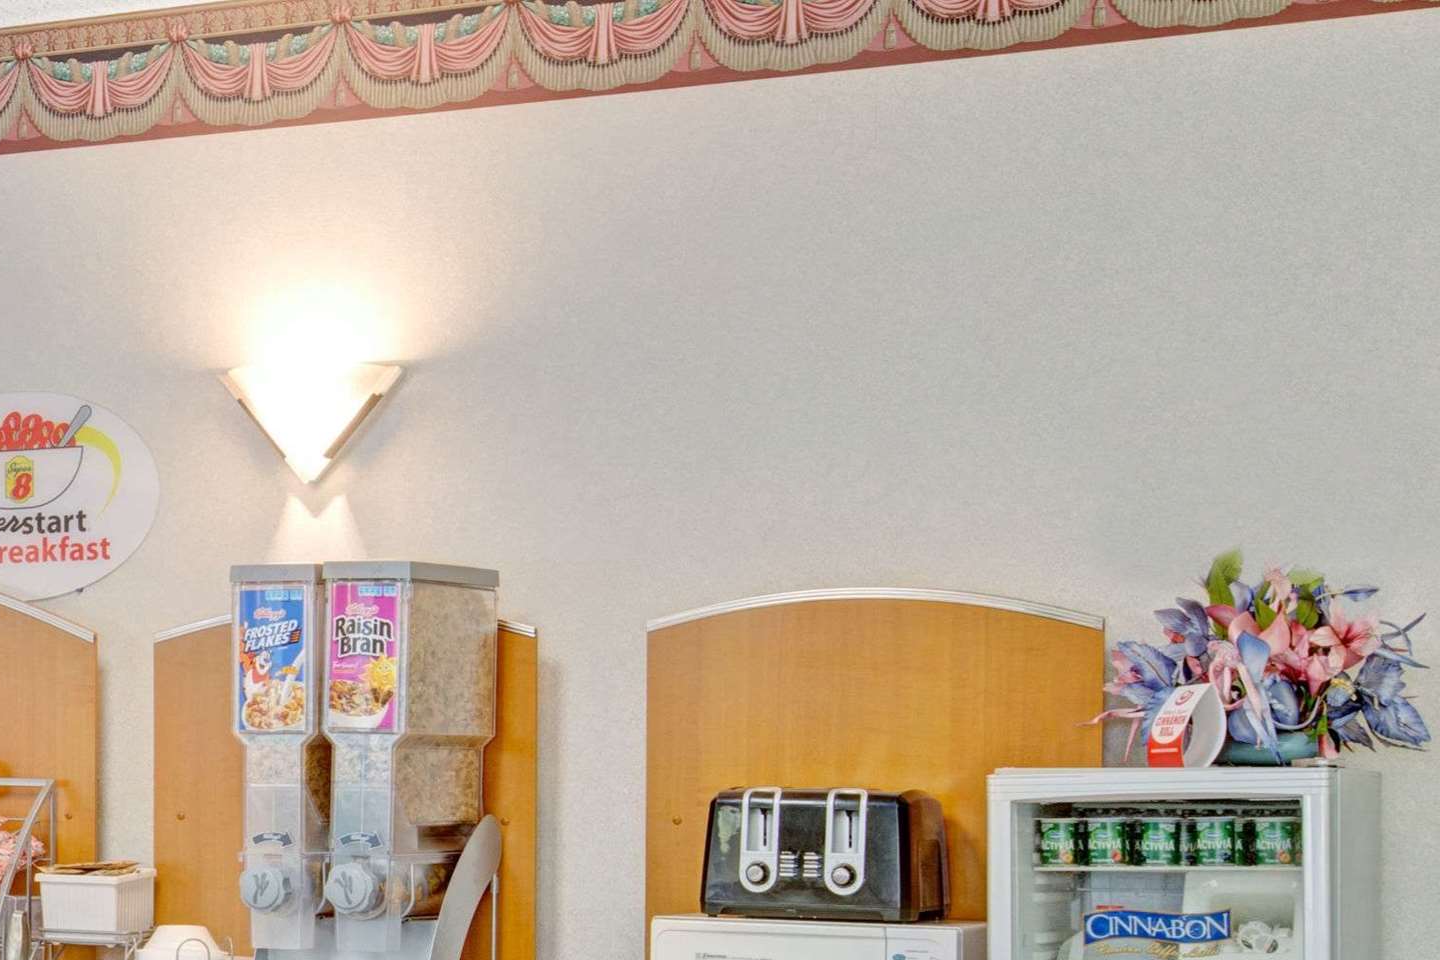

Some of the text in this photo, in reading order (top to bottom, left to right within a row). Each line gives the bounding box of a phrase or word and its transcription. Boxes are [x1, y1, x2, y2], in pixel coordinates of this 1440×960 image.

[12, 473, 32, 499] 8
[245, 620, 298, 641] FROSTED
[335, 617, 392, 639] Raisin
[245, 633, 291, 651] FLAKES
[340, 637, 385, 655] Bran
[1086, 912, 1229, 939] CINNABON
